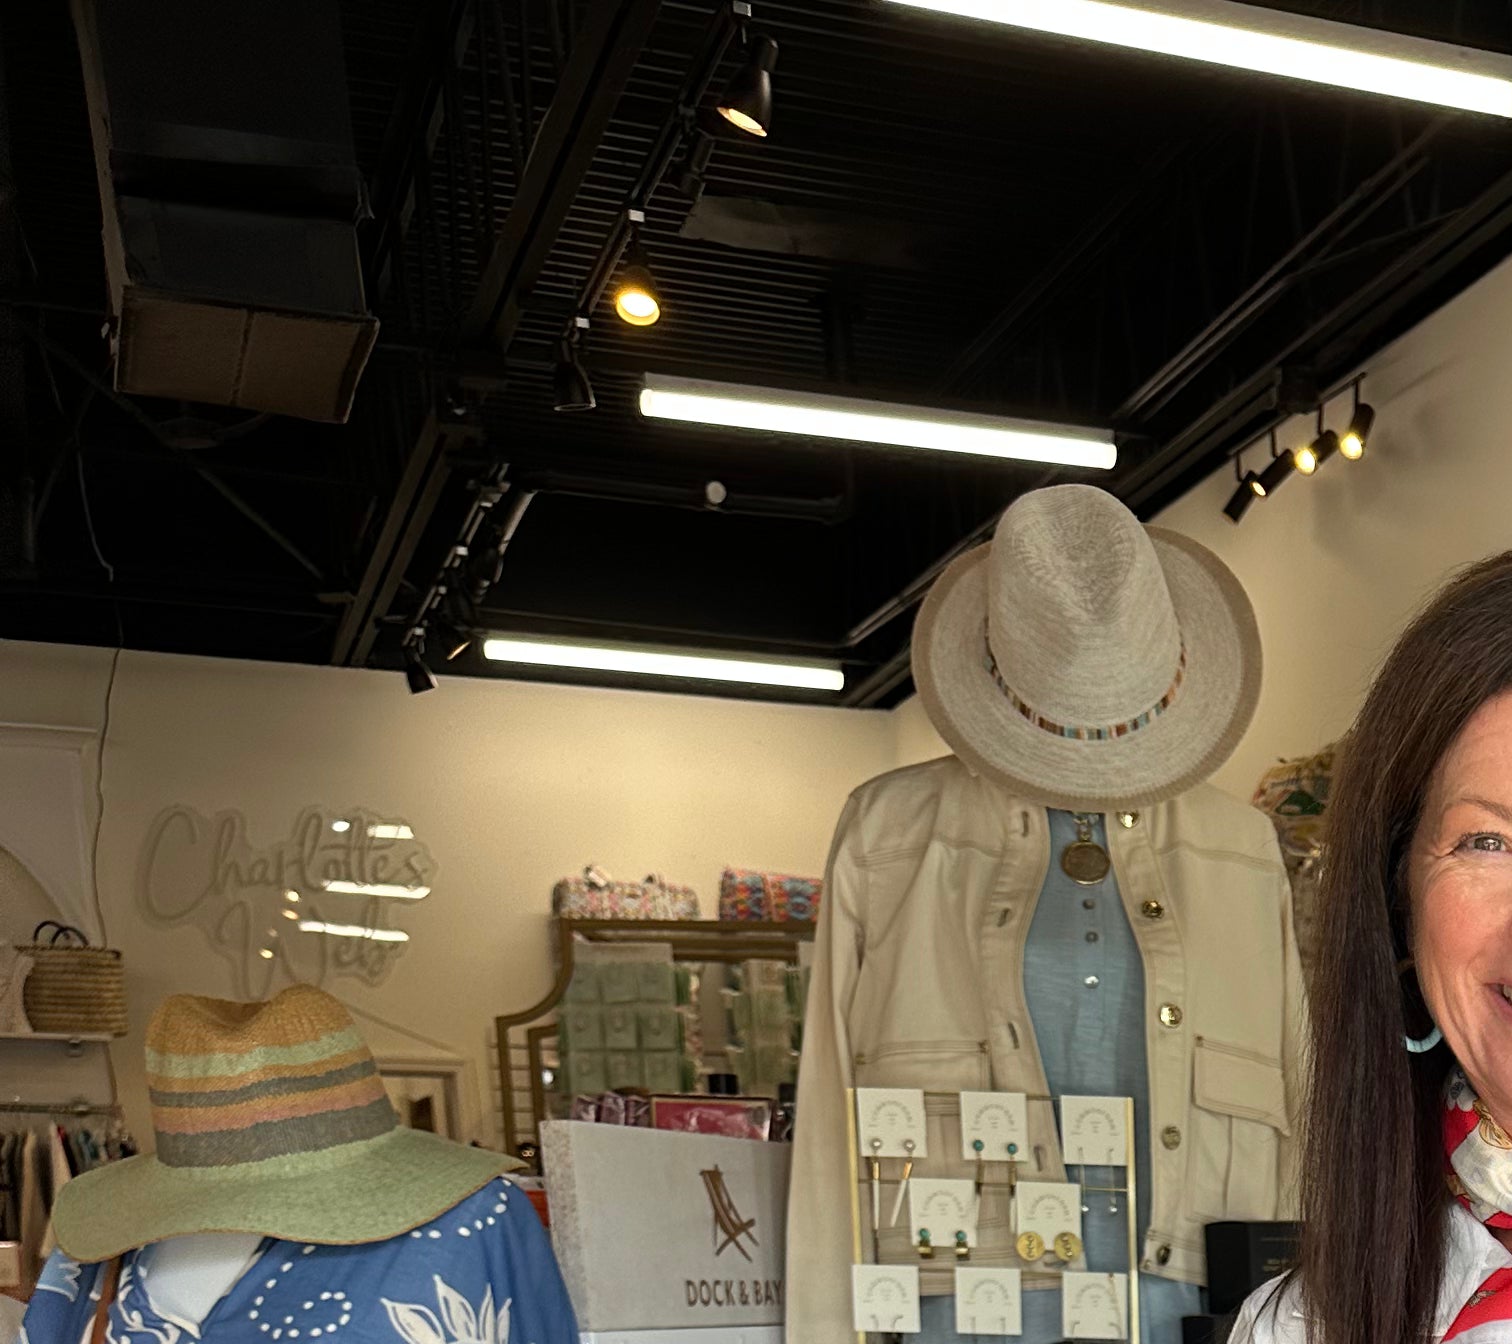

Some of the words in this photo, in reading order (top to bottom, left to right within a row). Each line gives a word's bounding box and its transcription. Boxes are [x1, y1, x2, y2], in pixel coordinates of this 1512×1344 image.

[685, 1279, 735, 1308] DOCK
[738, 1279, 750, 1307] &
[753, 1279, 785, 1306] BAY
